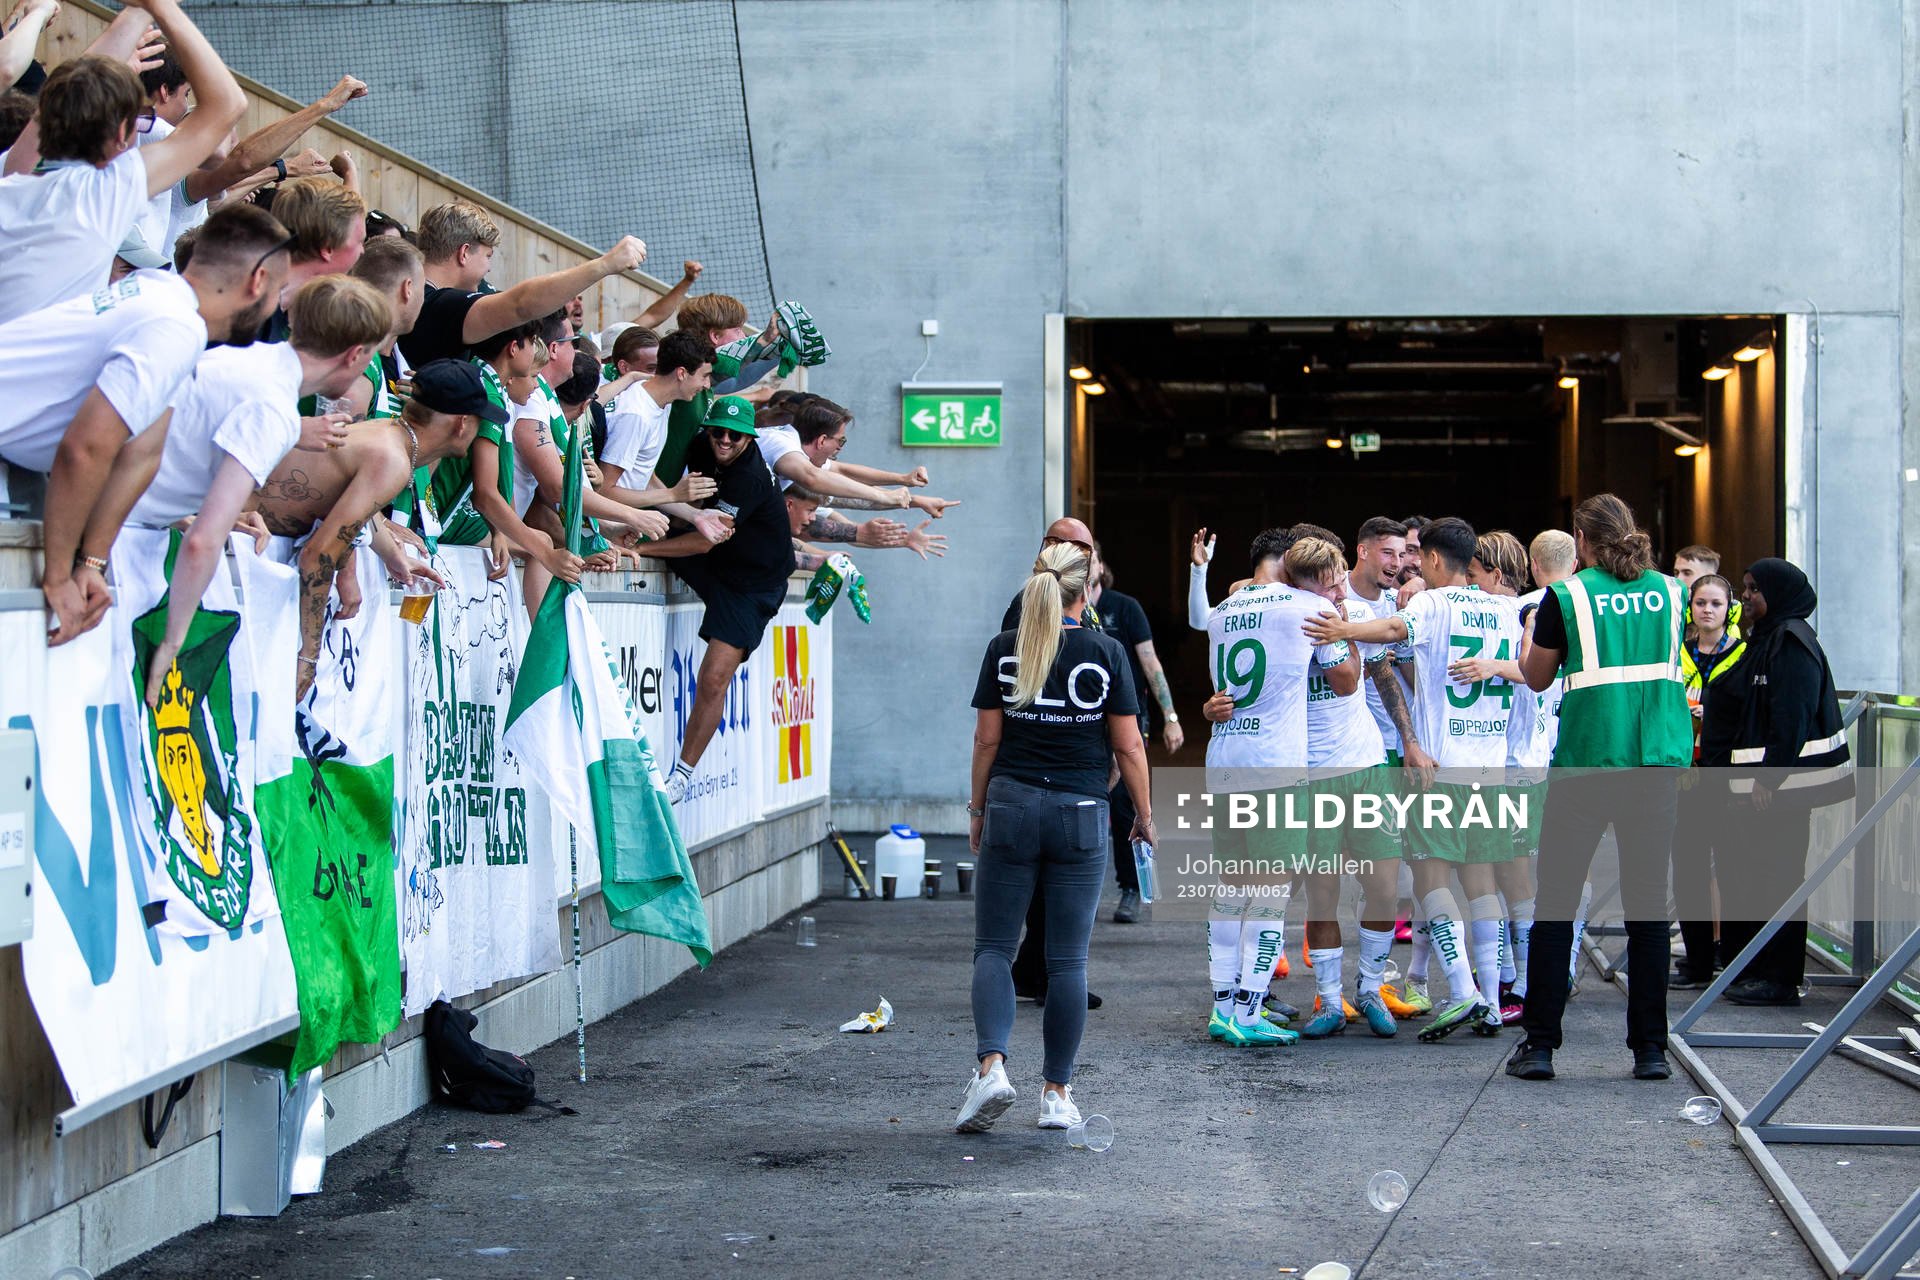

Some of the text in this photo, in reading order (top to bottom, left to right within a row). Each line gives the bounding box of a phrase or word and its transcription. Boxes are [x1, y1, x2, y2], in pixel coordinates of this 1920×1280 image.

[1594, 590, 1664, 616] FOTO
[1224, 612, 1263, 633] ERABI
[1217, 638, 1267, 709] 19
[1446, 635, 1514, 709] 34
[1004, 710, 1103, 723] pporter Liaison Officer
[1253, 930, 1282, 974] Clinton
